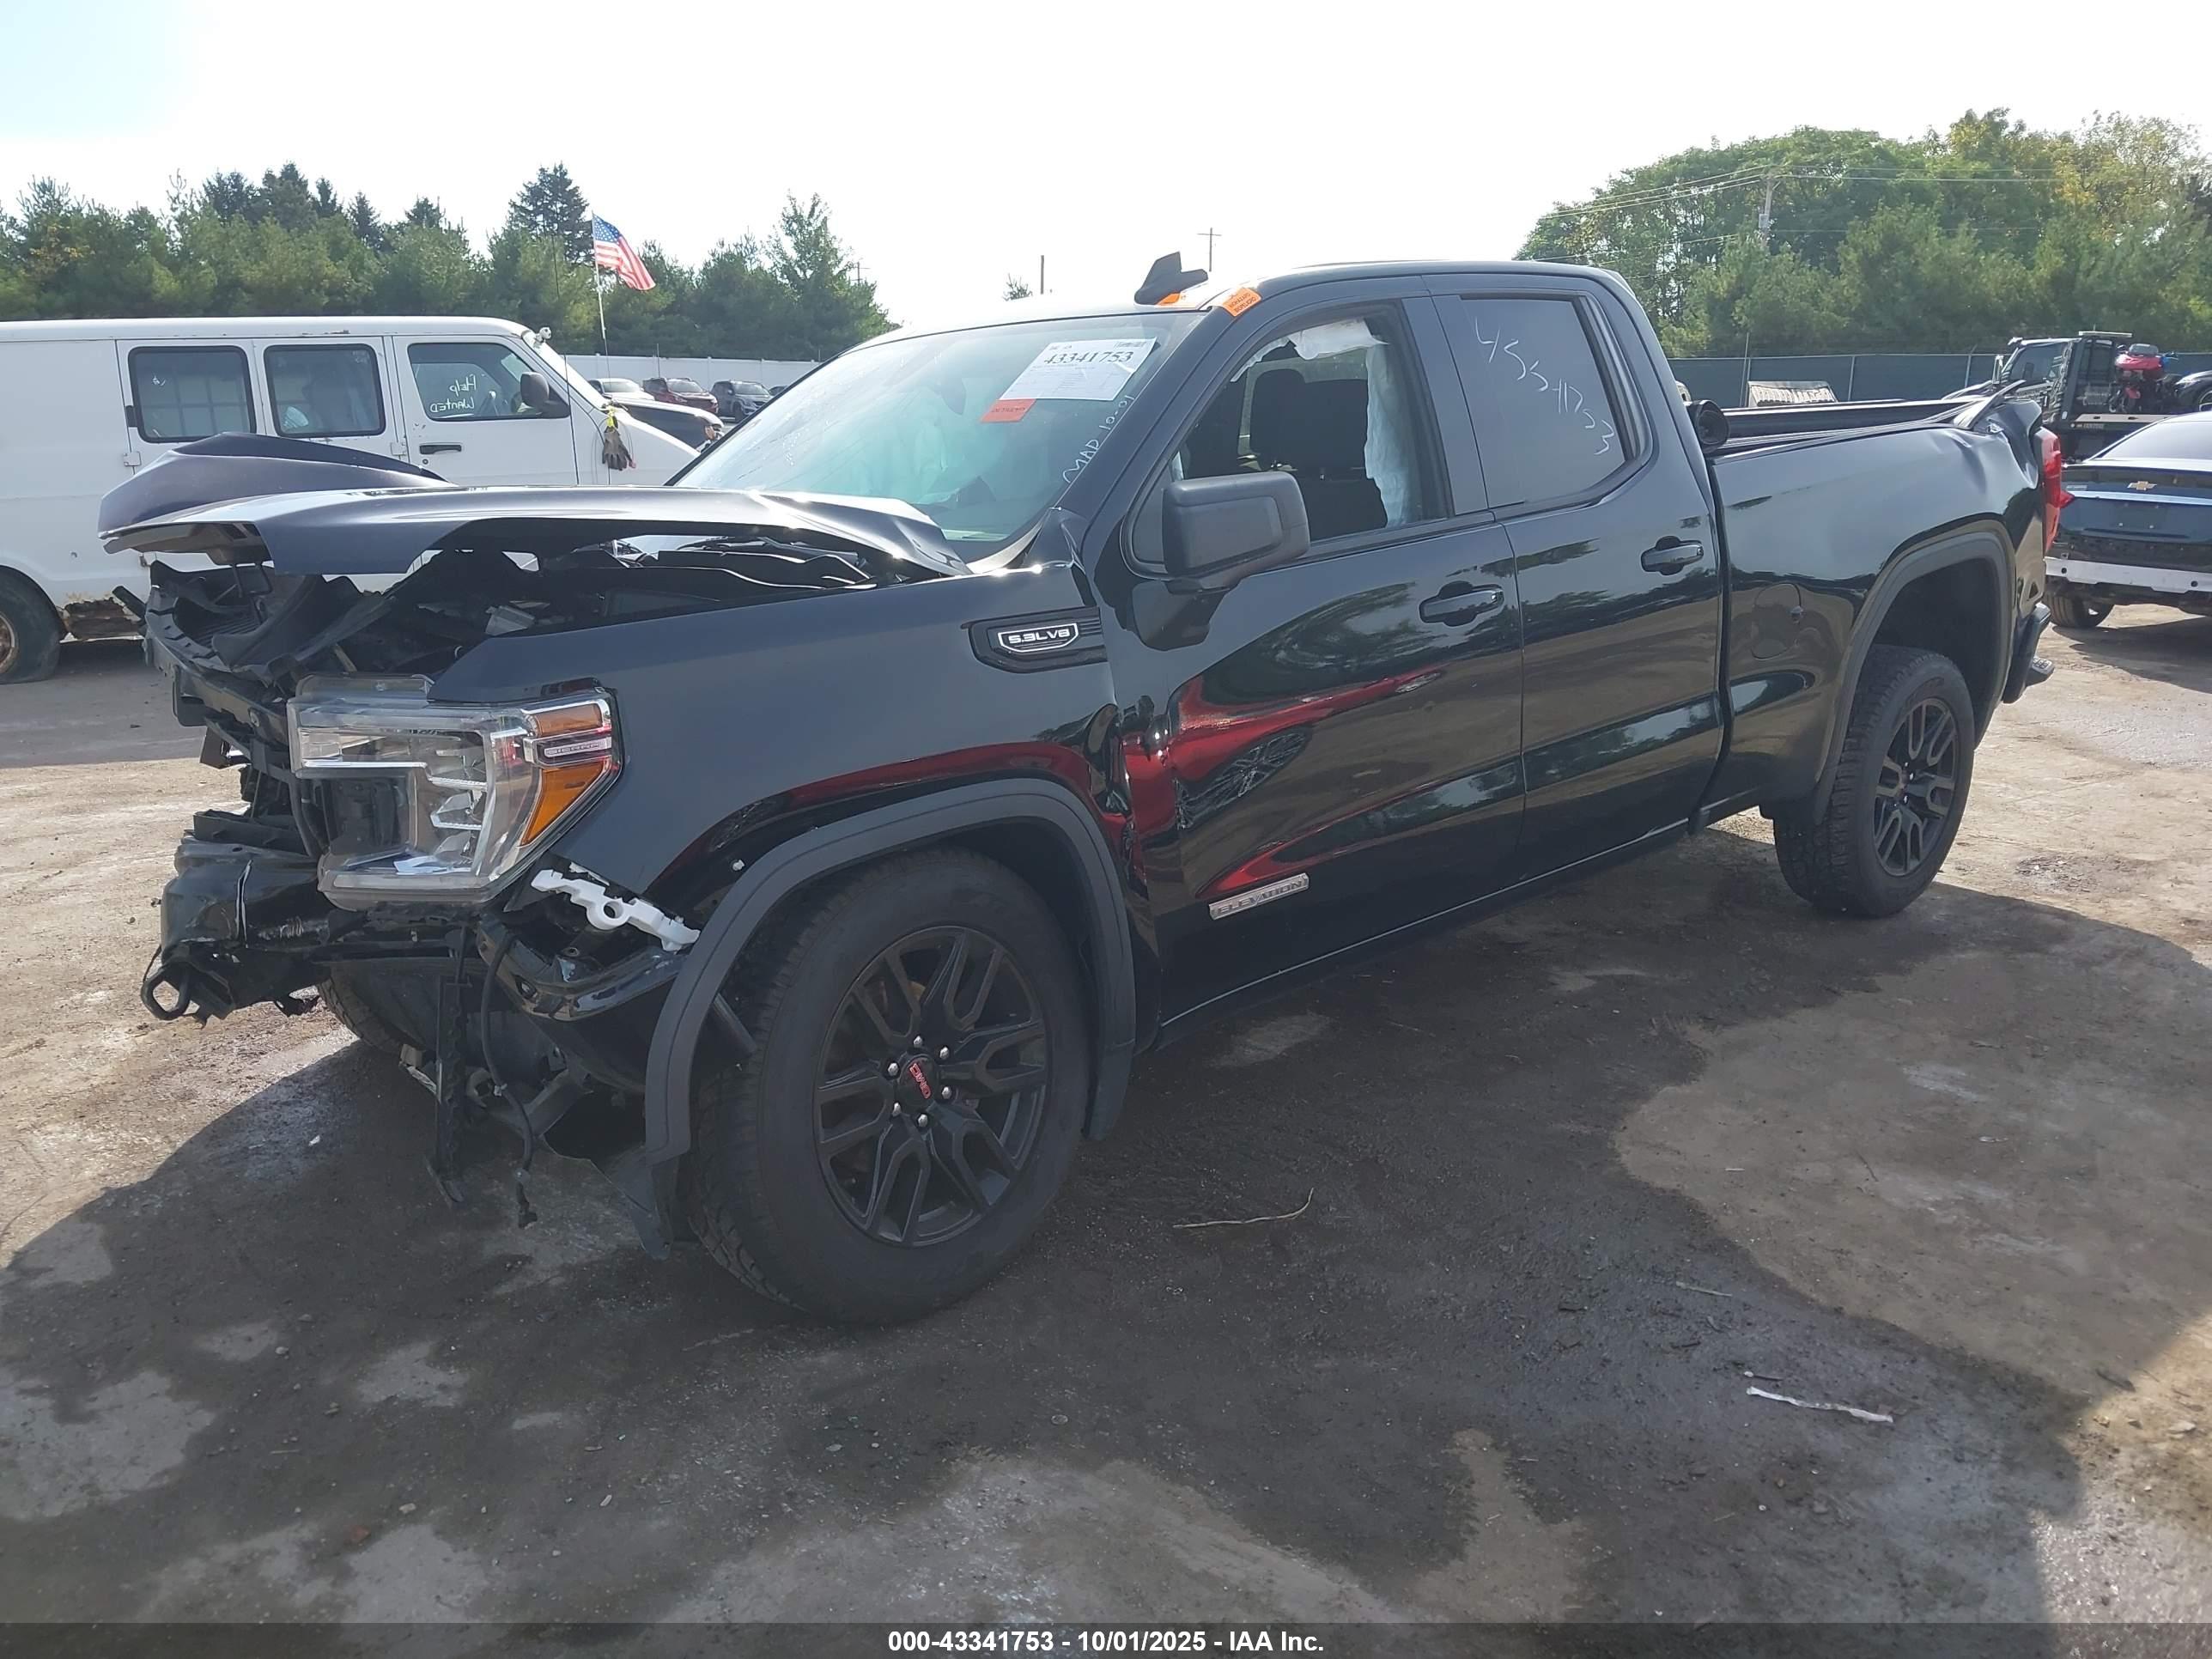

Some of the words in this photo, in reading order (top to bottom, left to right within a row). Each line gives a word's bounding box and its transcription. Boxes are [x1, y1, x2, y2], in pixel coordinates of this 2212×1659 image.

[1043, 351, 1134, 363] 43341753
[1218, 880, 1303, 914] ELEVATION
[909, 1062, 932, 1099] GMC
